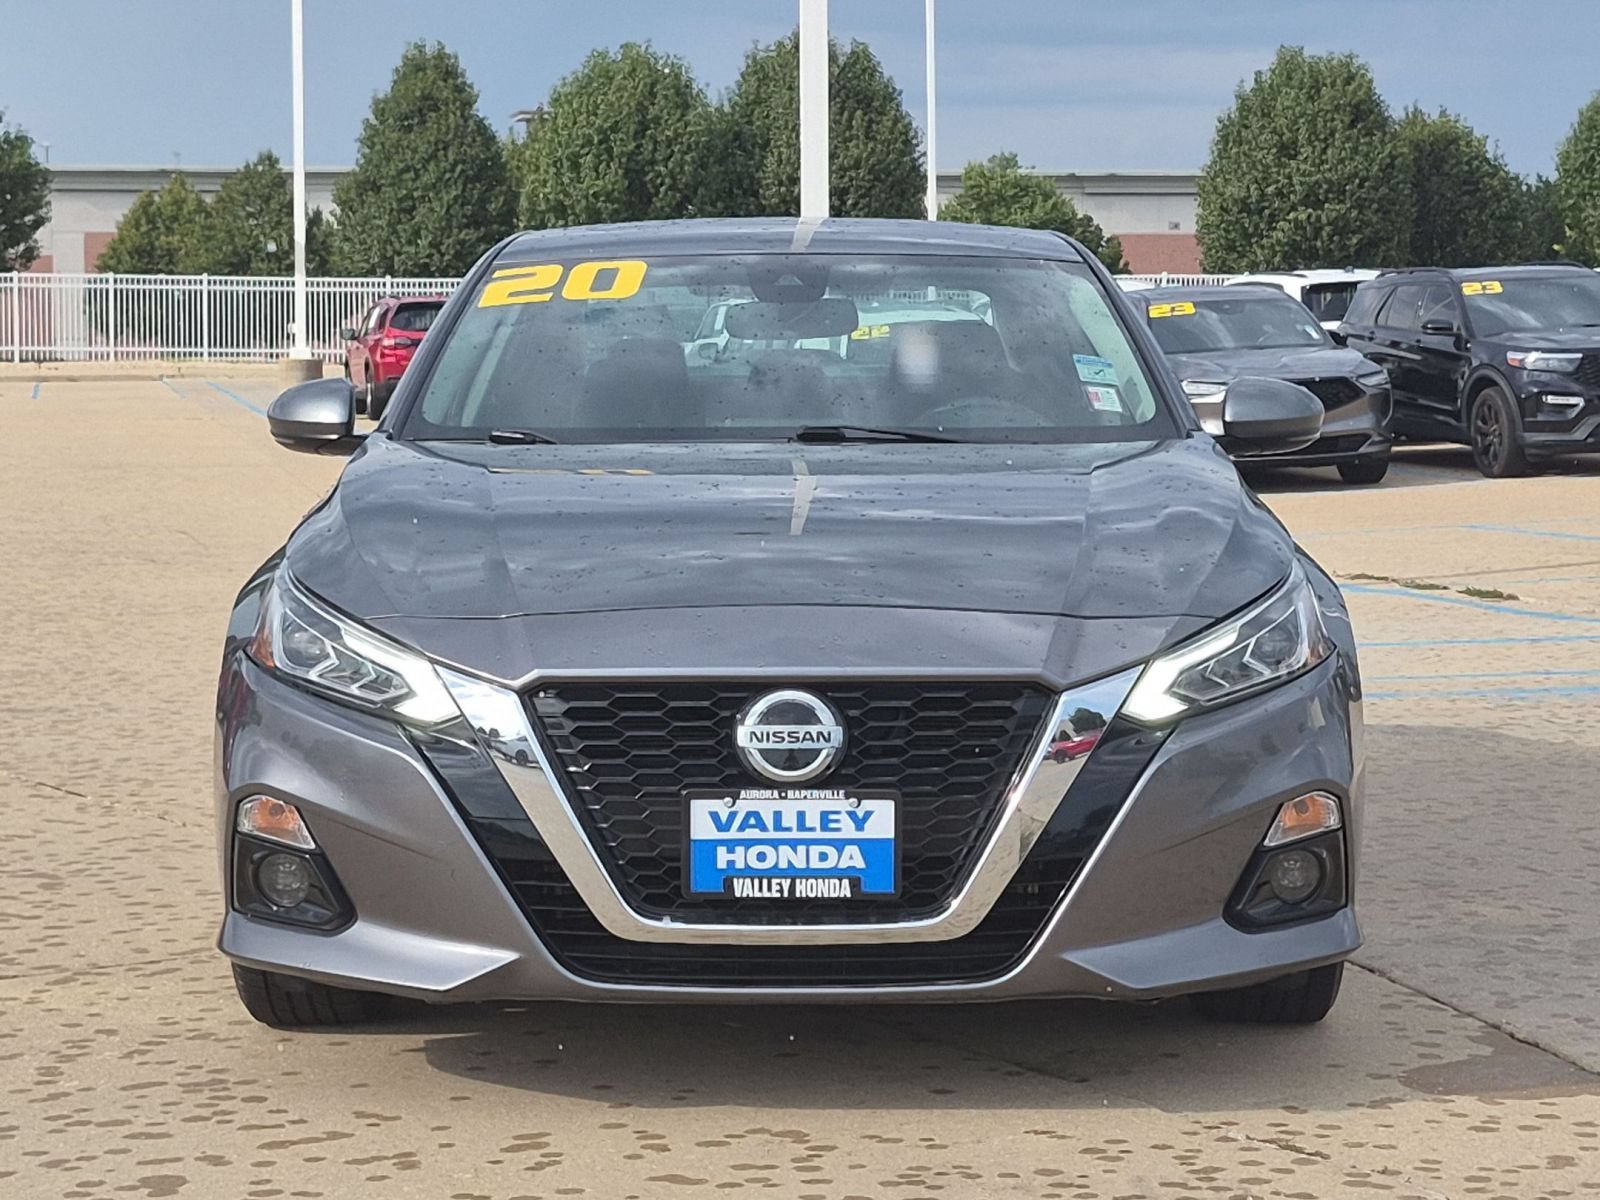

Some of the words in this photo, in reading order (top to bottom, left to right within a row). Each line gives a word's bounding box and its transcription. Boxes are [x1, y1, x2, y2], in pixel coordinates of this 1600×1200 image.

[478, 260, 648, 308] 20
[1461, 281, 1503, 295] 23
[1148, 302, 1196, 318] 23
[749, 731, 832, 744] NISSAN
[740, 789, 779, 799] AURORA
[787, 789, 845, 799] NAPERVILLE
[708, 810, 875, 833] VALLEY
[716, 845, 866, 869] HONDA
[733, 878, 790, 897] VALLEY
[795, 878, 851, 897] HONDA
